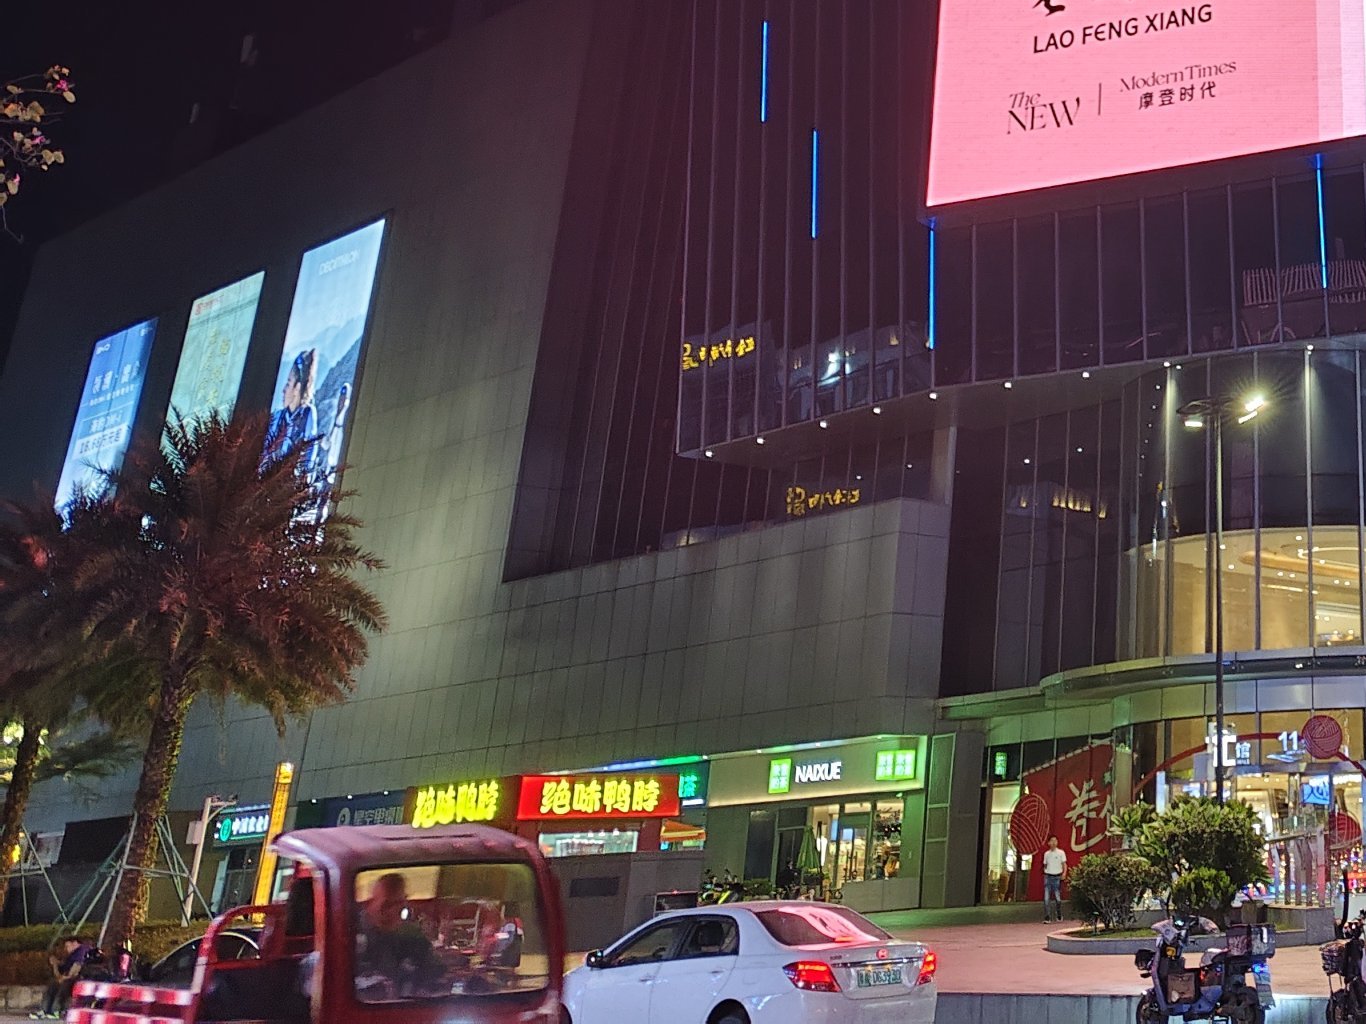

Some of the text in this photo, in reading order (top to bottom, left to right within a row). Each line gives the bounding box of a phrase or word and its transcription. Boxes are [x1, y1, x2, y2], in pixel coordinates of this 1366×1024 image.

[1033, 4, 1213, 54] LAO FENG XIANG
[1007, 92, 1041, 110] The
[1138, 82, 1216, 110] 摩登时代
[1006, 97, 1081, 134] NEW
[795, 761, 842, 783] NAIXUE
[540, 778, 660, 815] 绝味鸭脖
